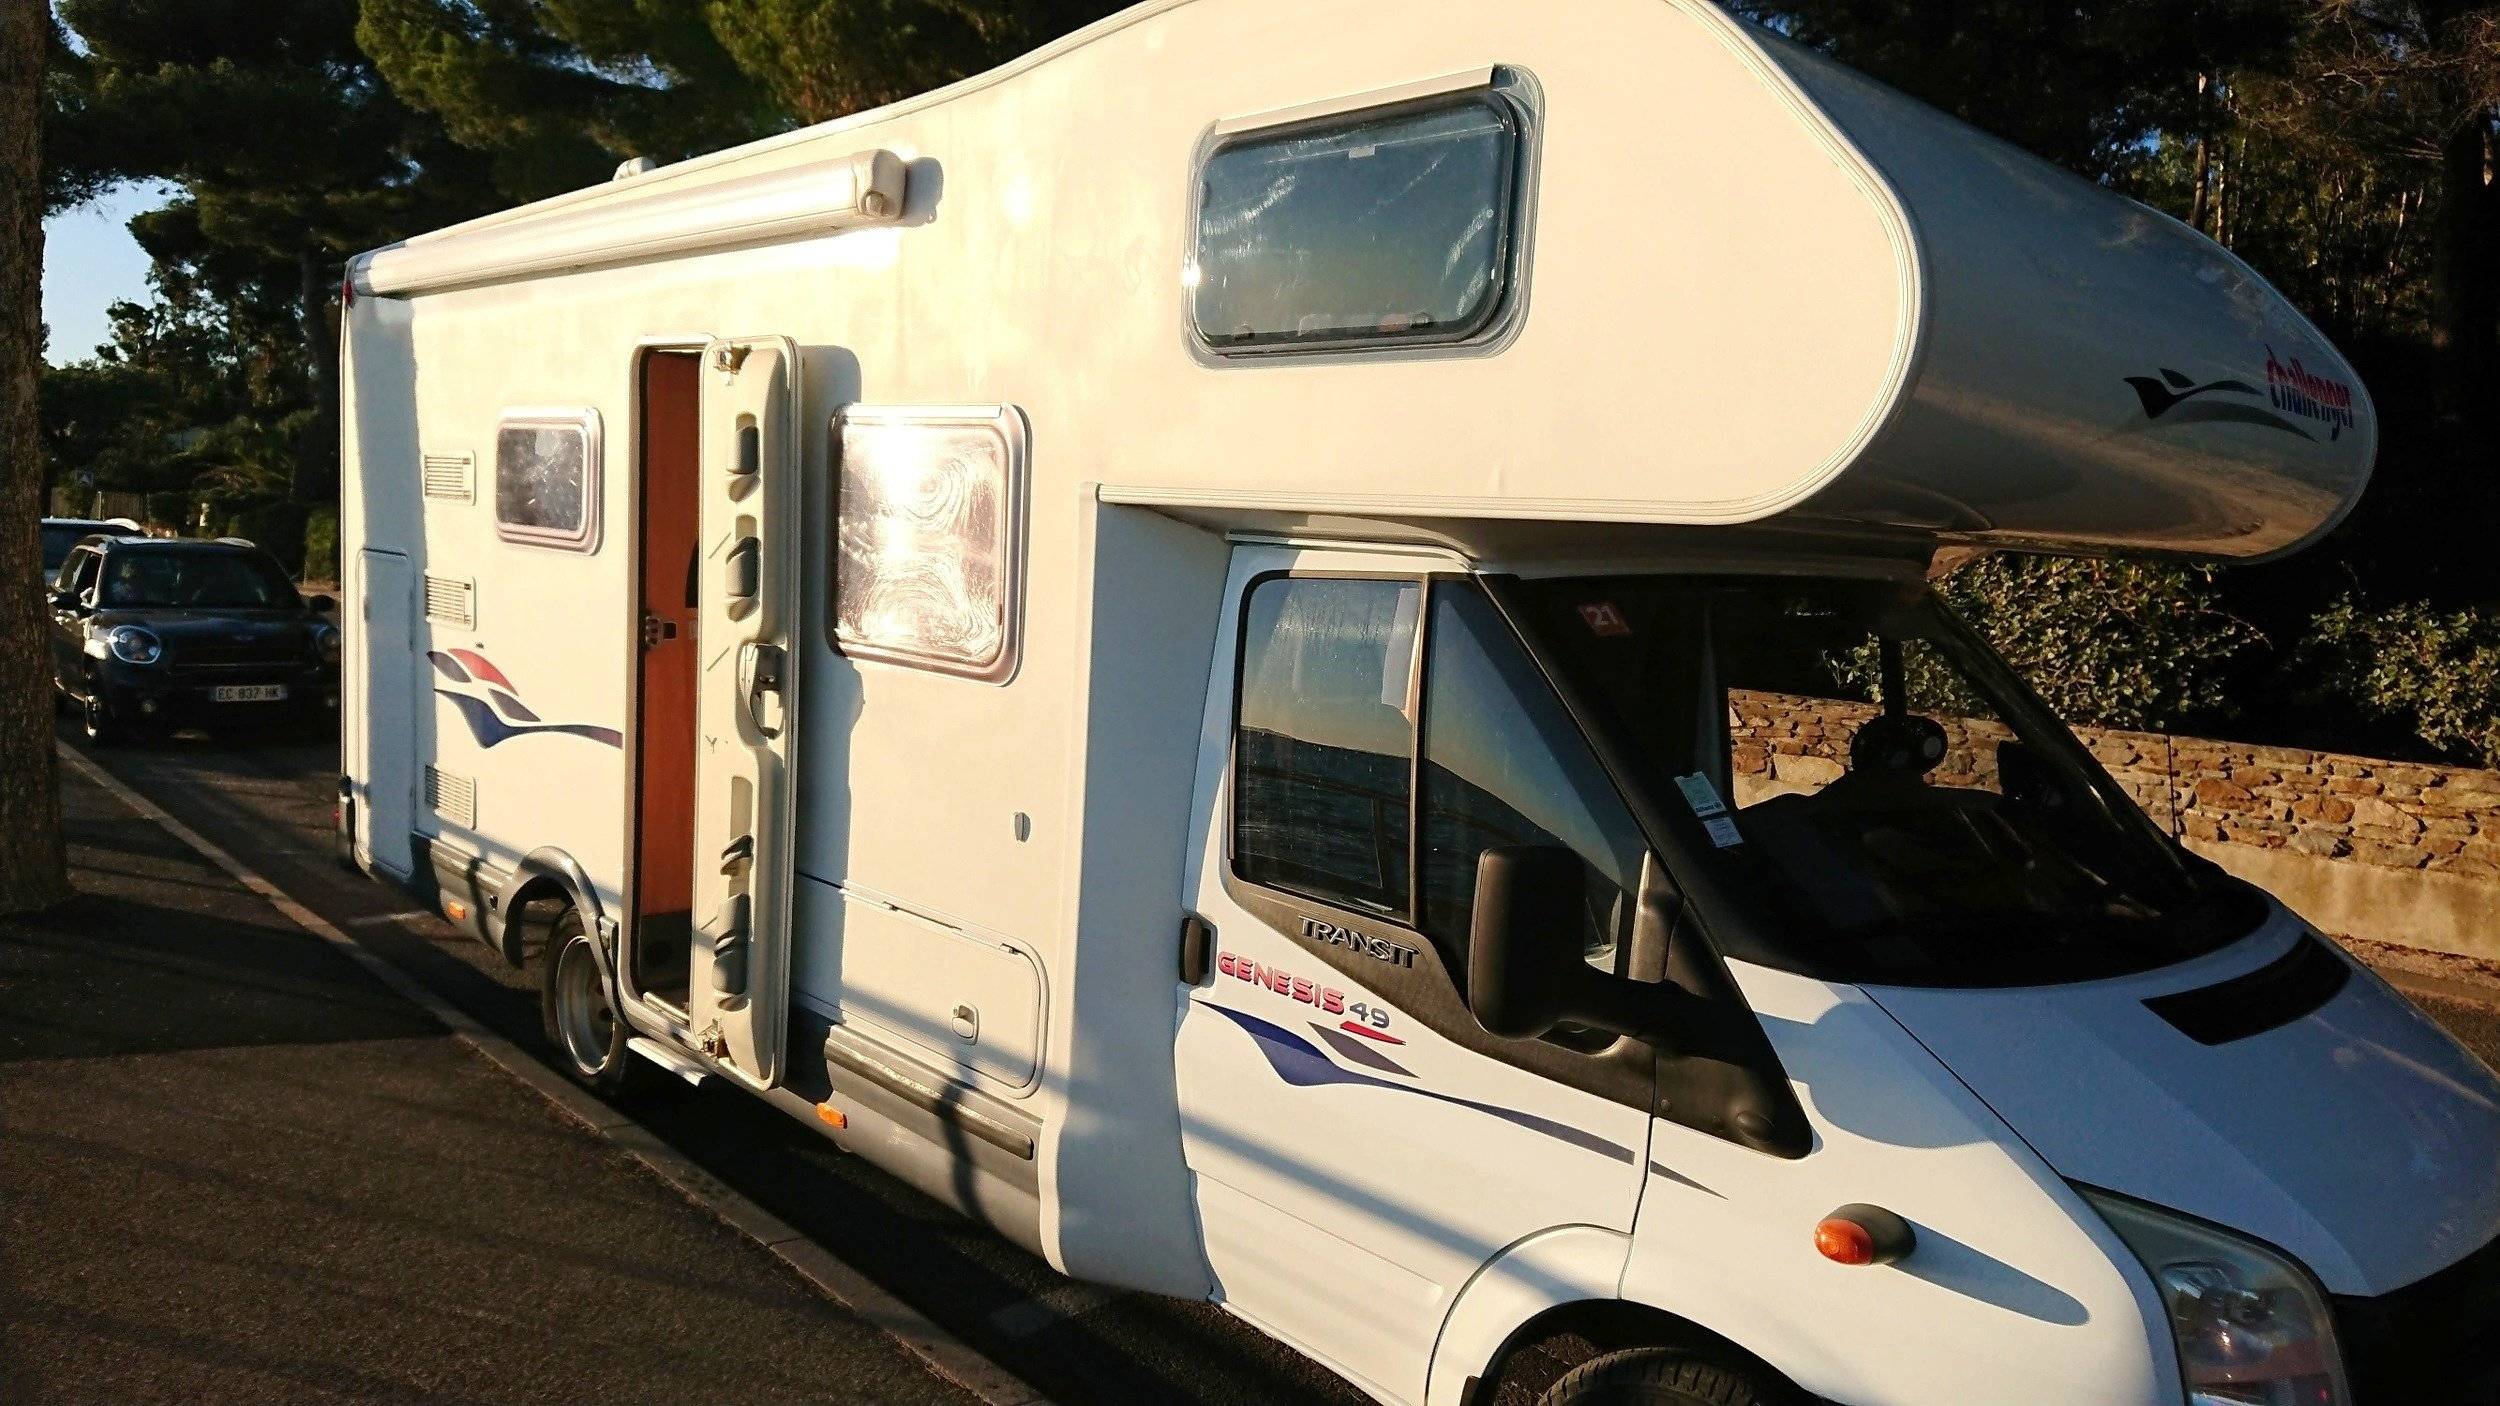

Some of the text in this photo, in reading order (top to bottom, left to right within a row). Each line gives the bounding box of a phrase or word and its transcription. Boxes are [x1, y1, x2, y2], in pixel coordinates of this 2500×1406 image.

[2265, 343, 2353, 441] Challenger
[1299, 915, 1421, 968] TRANSIT
[1217, 951, 1391, 1029] GENESIS 49
